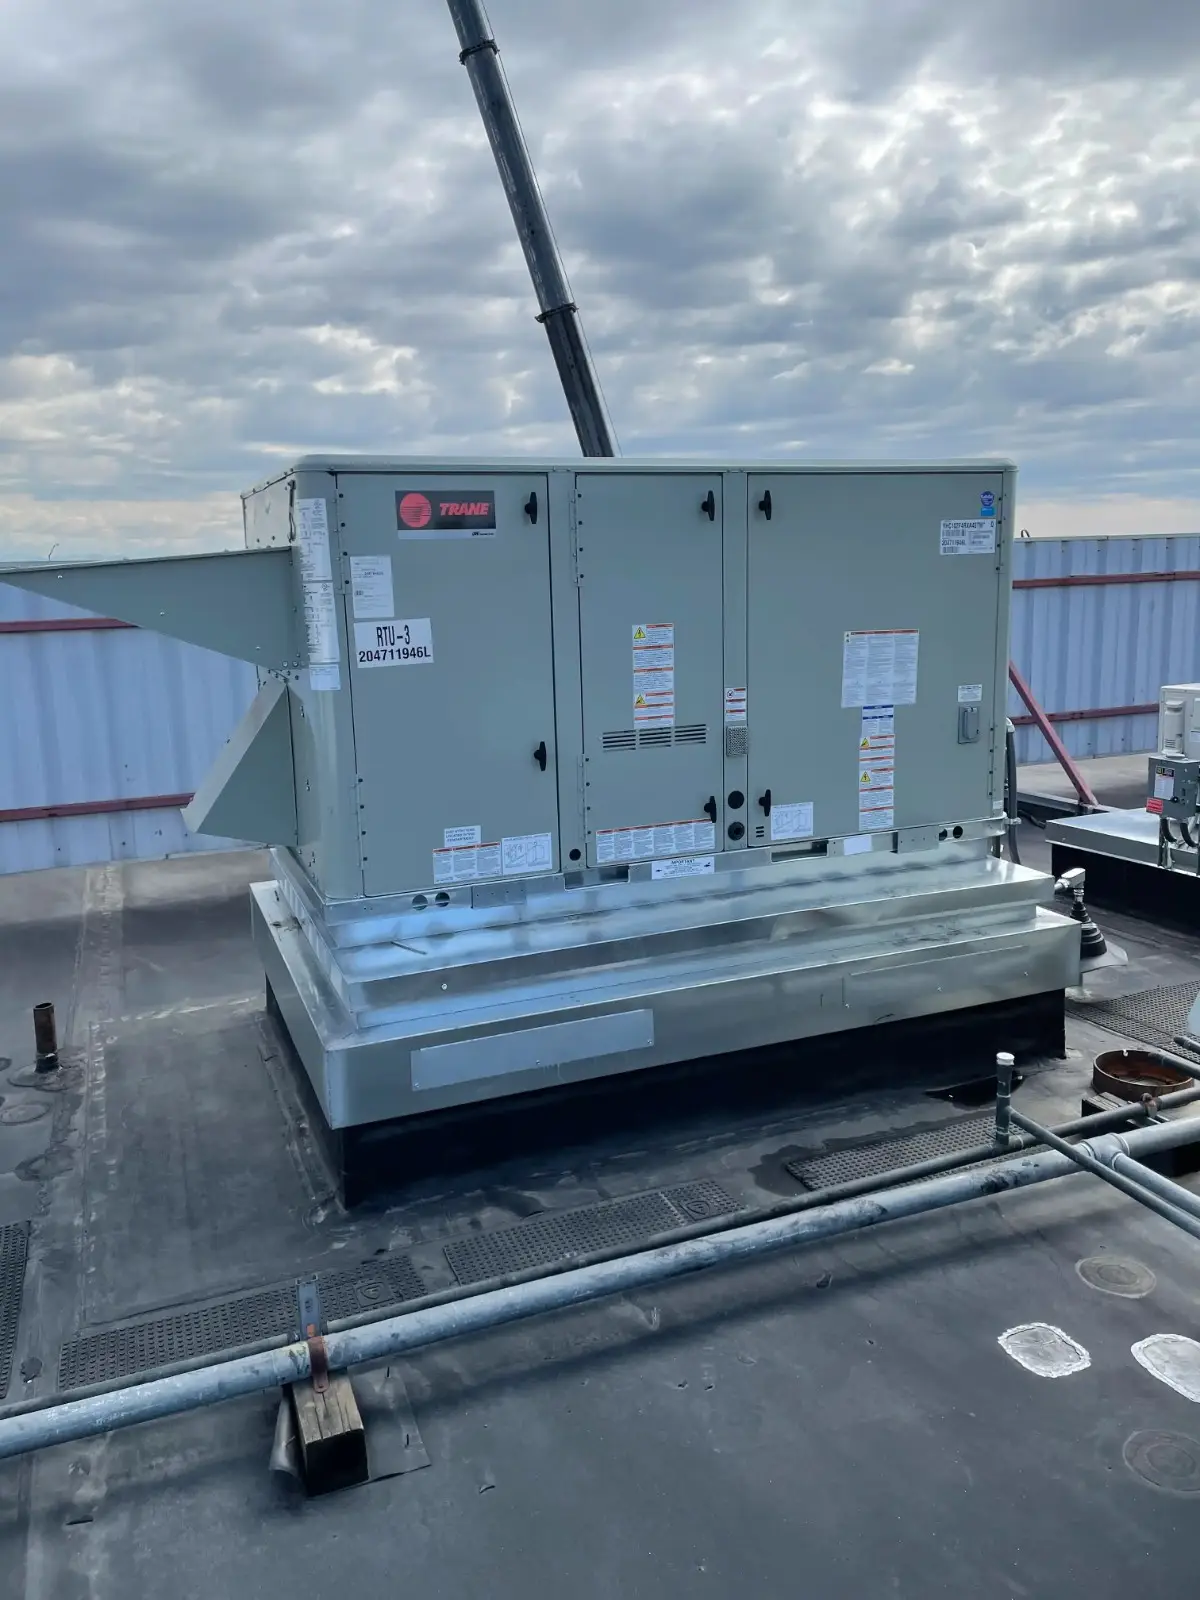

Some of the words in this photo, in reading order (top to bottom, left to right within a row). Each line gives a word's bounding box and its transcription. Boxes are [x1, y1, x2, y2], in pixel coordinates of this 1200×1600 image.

[439, 502, 489, 516] TRANE
[376, 625, 410, 647] RTU-3
[358, 646, 431, 663] 204711946L
